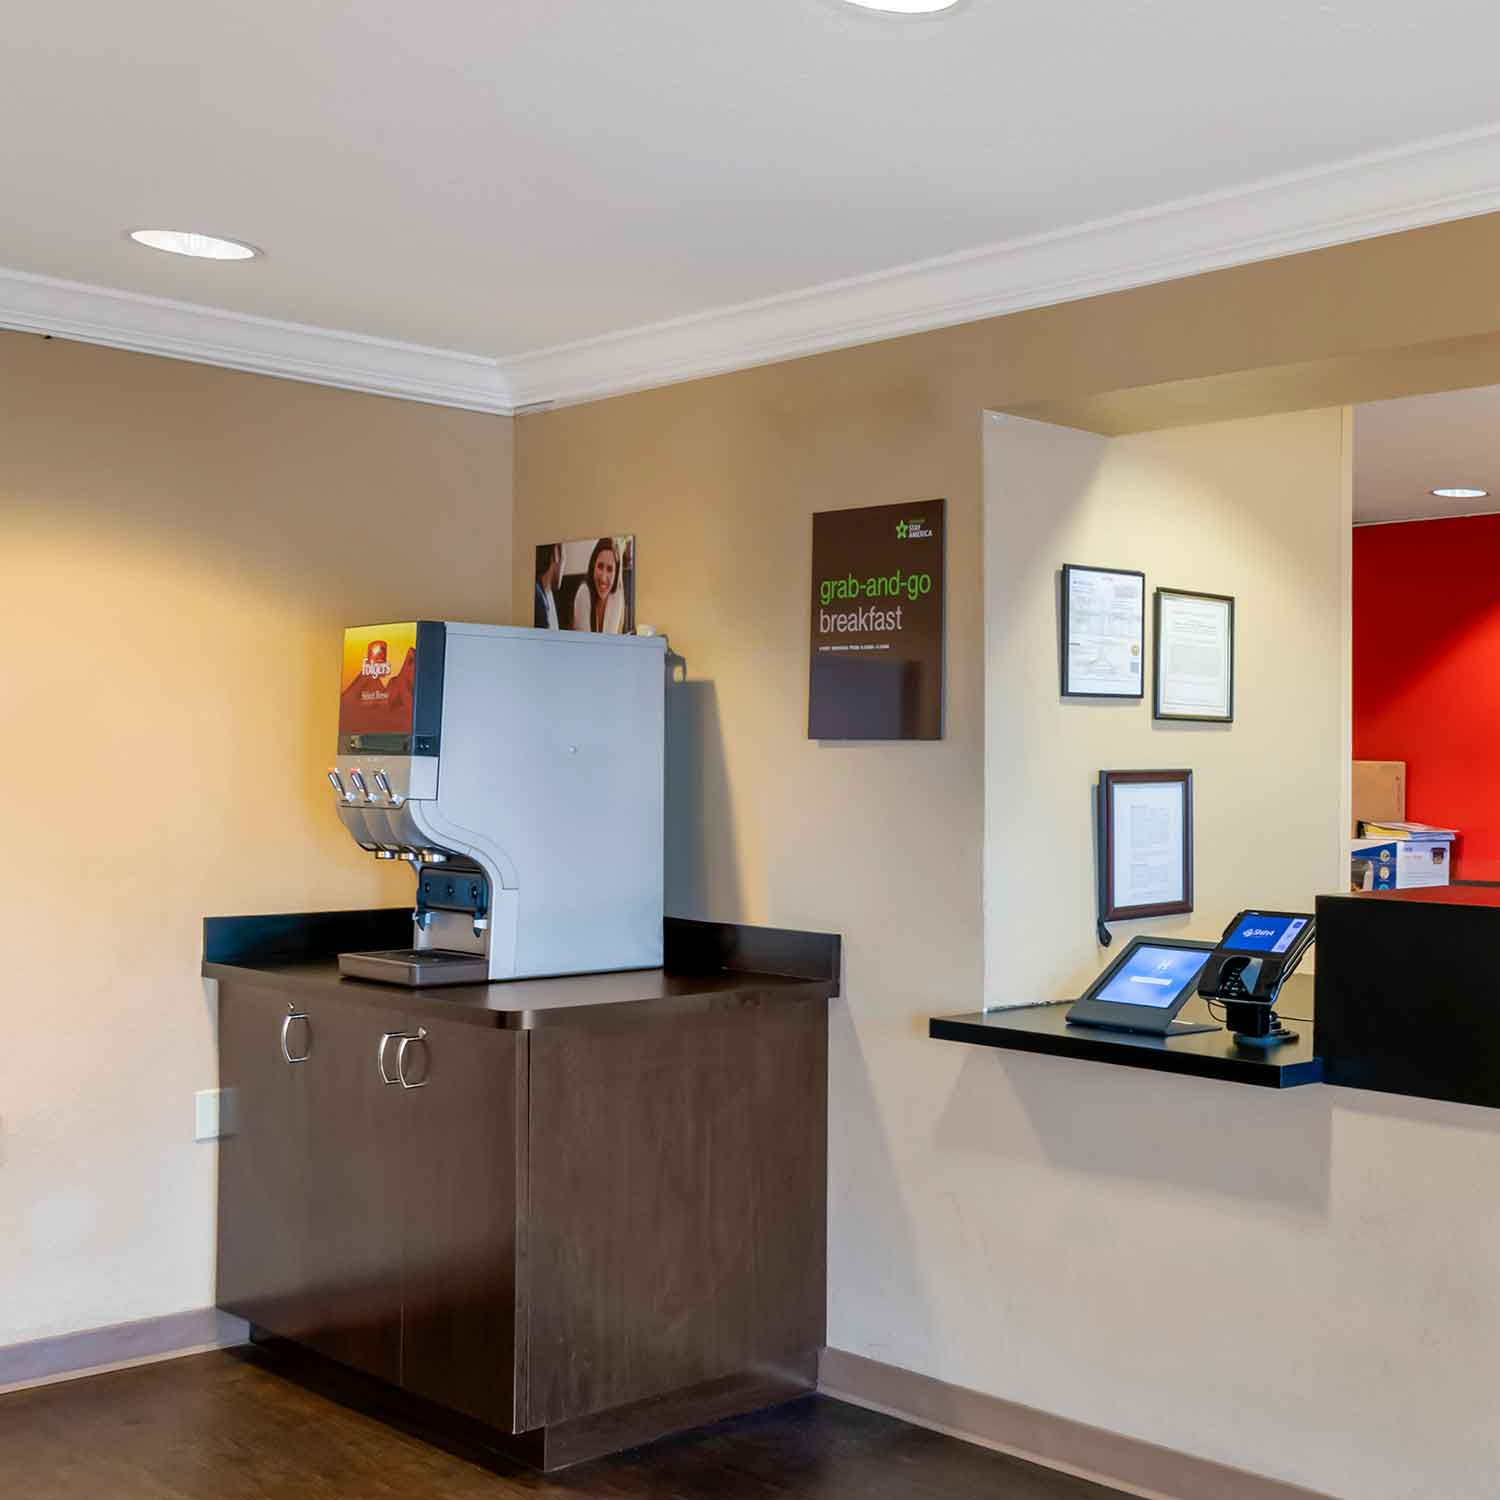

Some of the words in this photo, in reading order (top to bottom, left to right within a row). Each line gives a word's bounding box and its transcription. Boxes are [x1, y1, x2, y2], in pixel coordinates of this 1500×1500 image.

[820, 569, 932, 605] grab-and-go
[820, 605, 902, 633] breakfast
[362, 658, 391, 679] Folgers
